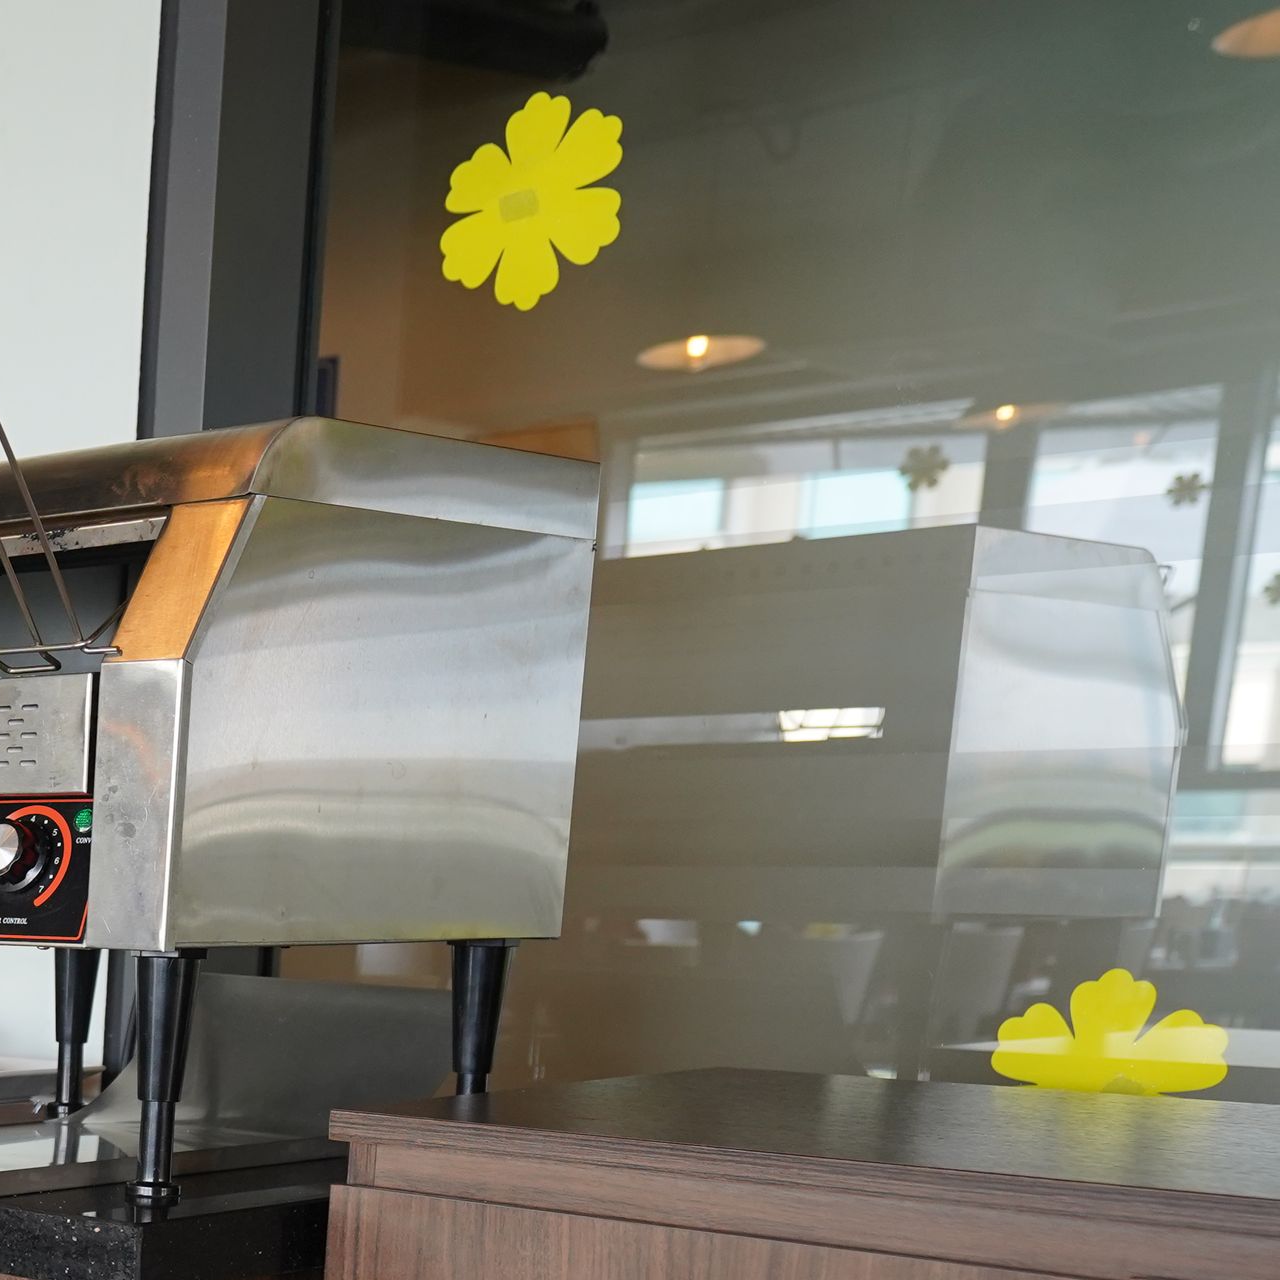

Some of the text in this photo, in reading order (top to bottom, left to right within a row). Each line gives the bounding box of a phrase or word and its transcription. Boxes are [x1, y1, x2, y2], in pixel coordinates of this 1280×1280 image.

[30, 815, 36, 823] 4
[52, 828, 58, 836] 5
[38, 885, 45, 893] 7
[2, 917, 28, 925] CONTROL
